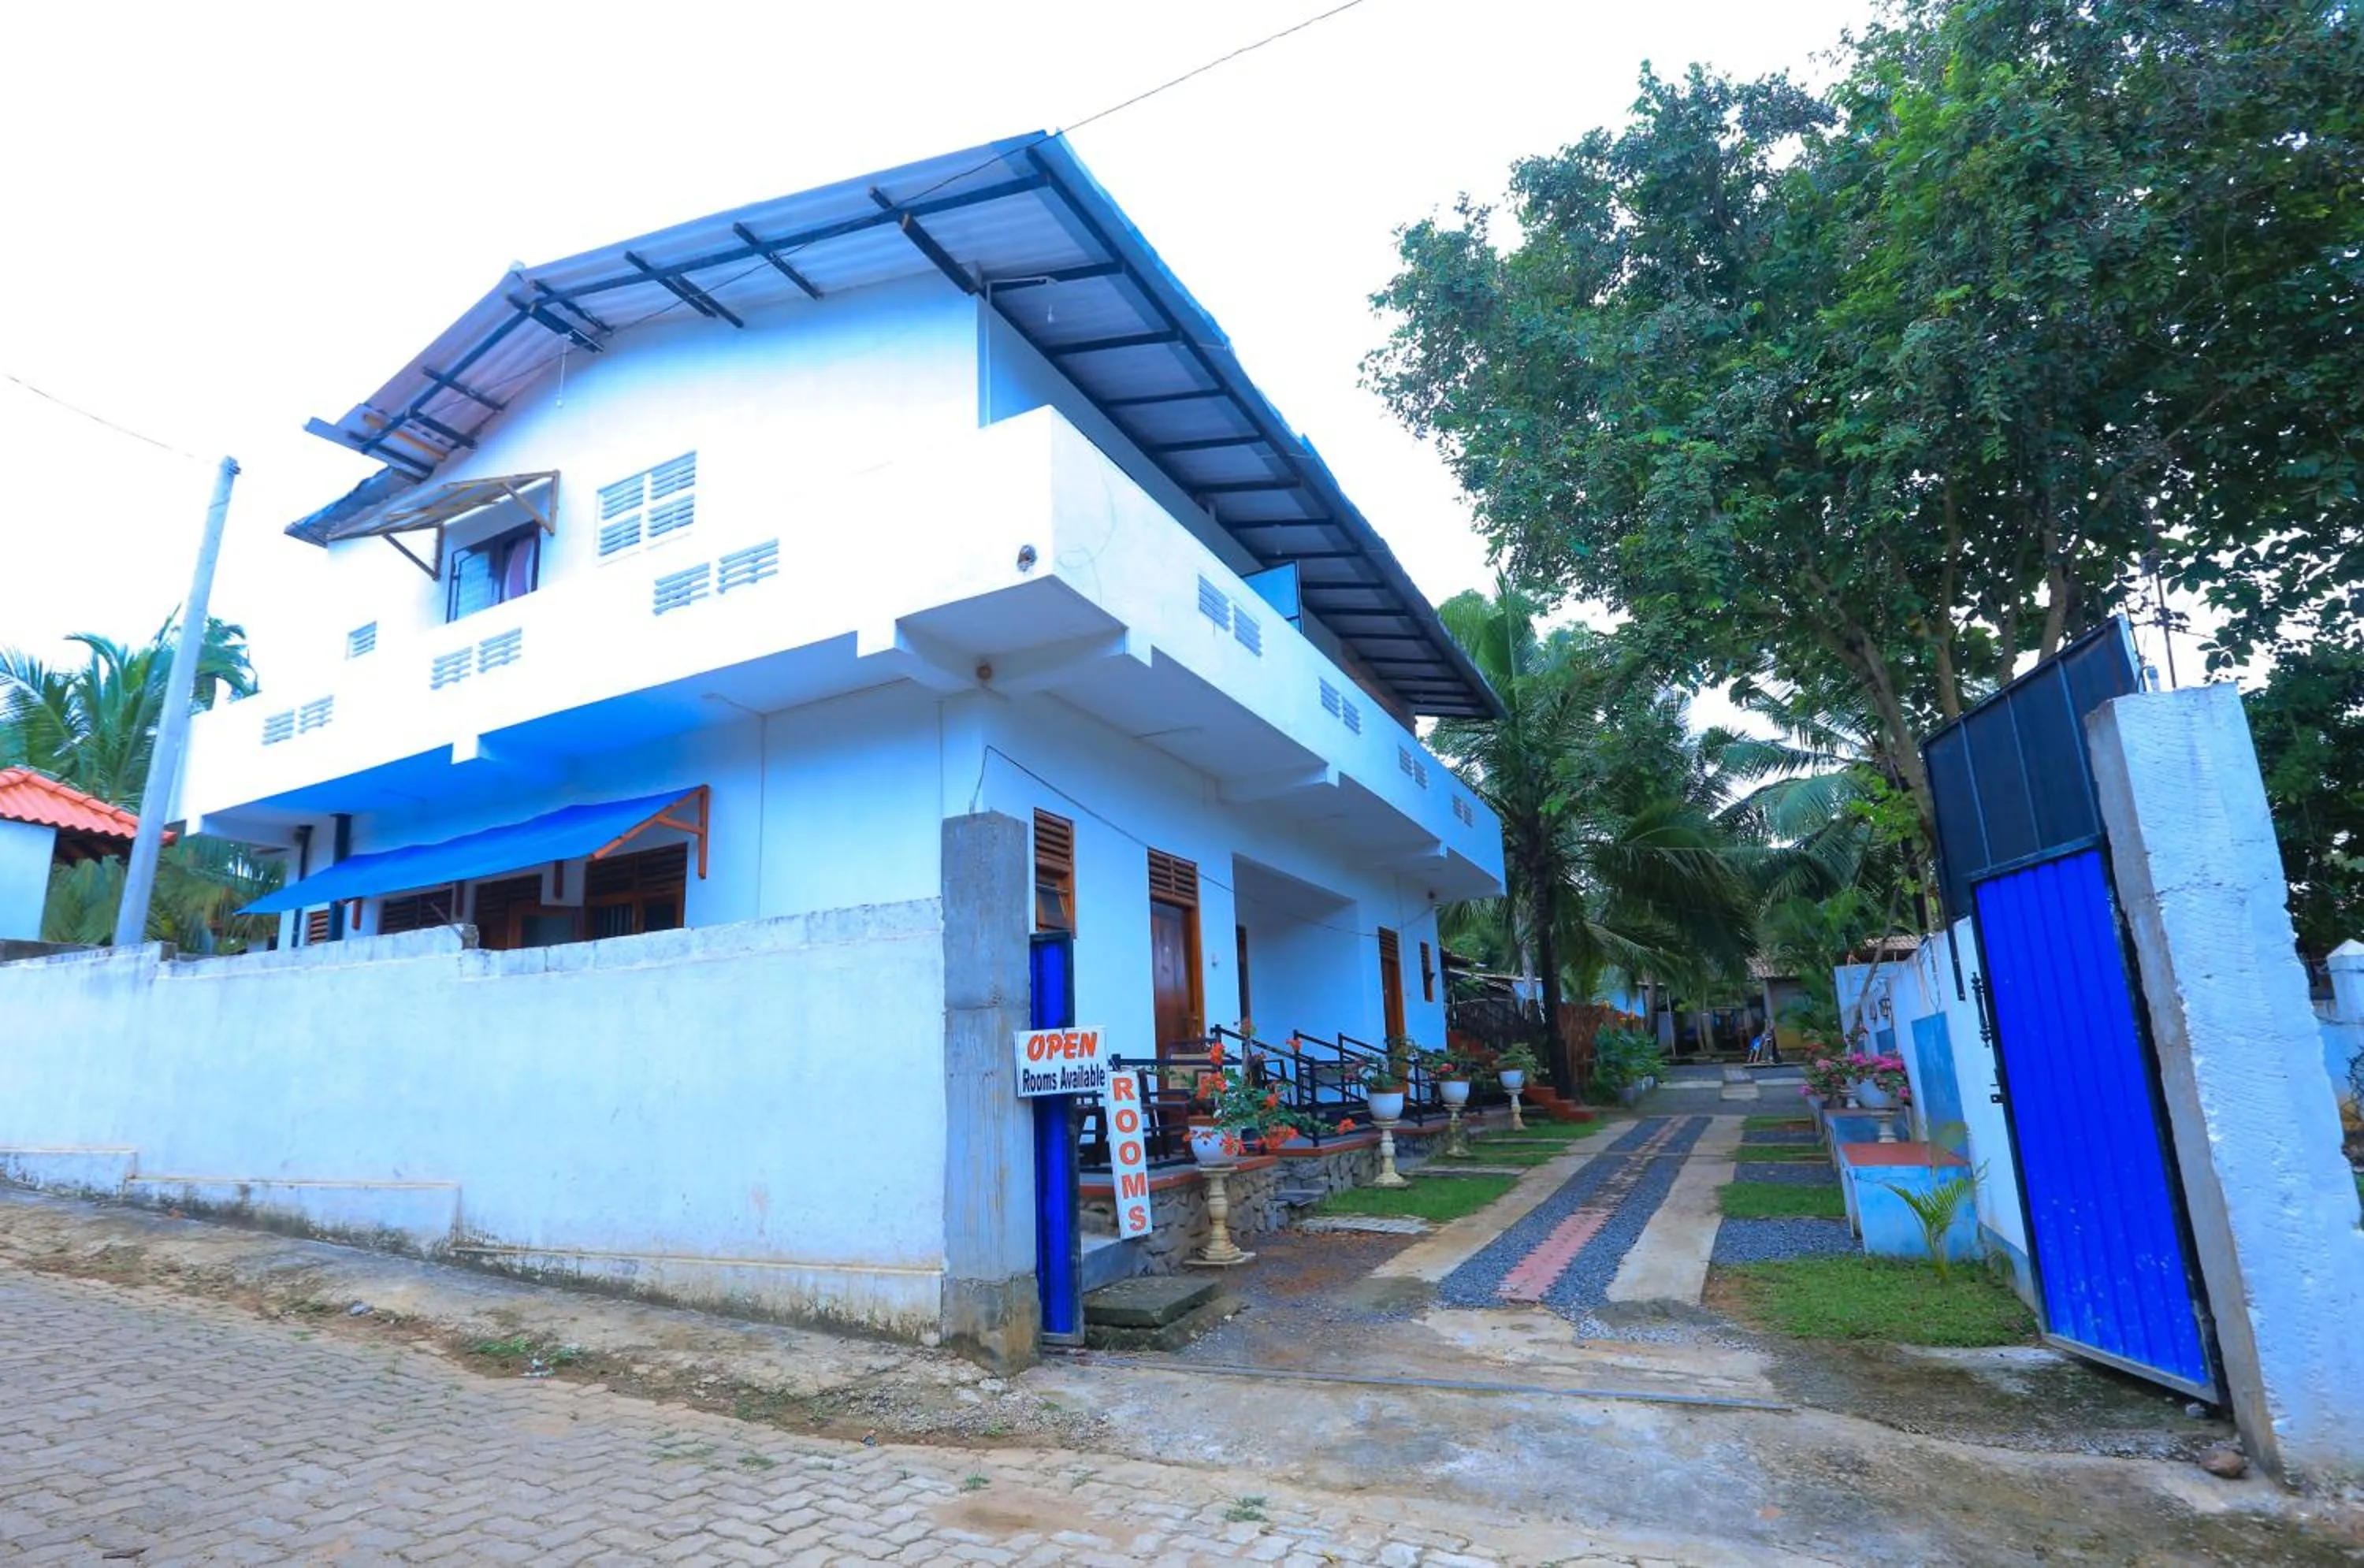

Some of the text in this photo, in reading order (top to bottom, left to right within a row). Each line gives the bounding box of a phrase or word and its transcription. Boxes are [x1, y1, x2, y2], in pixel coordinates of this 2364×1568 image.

[1027, 1032, 1098, 1061] OPEN
[1023, 1064, 1106, 1092] Rooms Available
[1112, 1077, 1147, 1232] ROOMS
